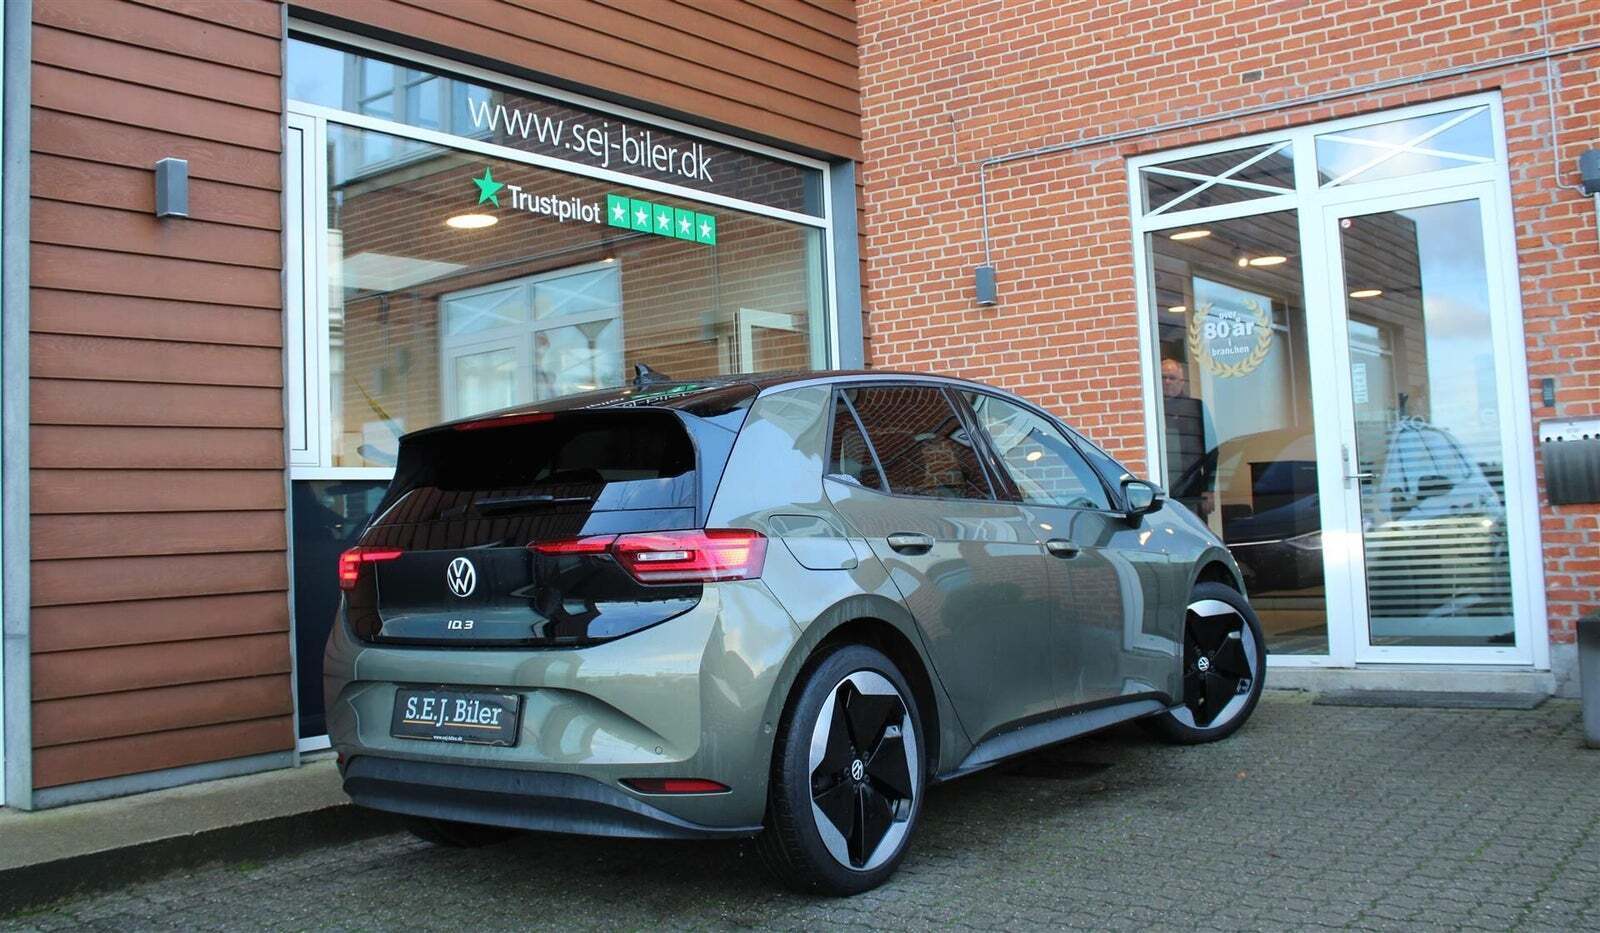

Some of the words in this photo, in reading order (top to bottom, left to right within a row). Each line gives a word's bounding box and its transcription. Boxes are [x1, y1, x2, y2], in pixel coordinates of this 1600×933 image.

[468, 97, 713, 183] www.sej-biler.dk
[507, 184, 600, 224] Trustpilot
[1204, 321, 1229, 339] 80
[1232, 317, 1255, 337] år
[405, 696, 449, 727] S.E.J.
[453, 699, 502, 725] Biler
